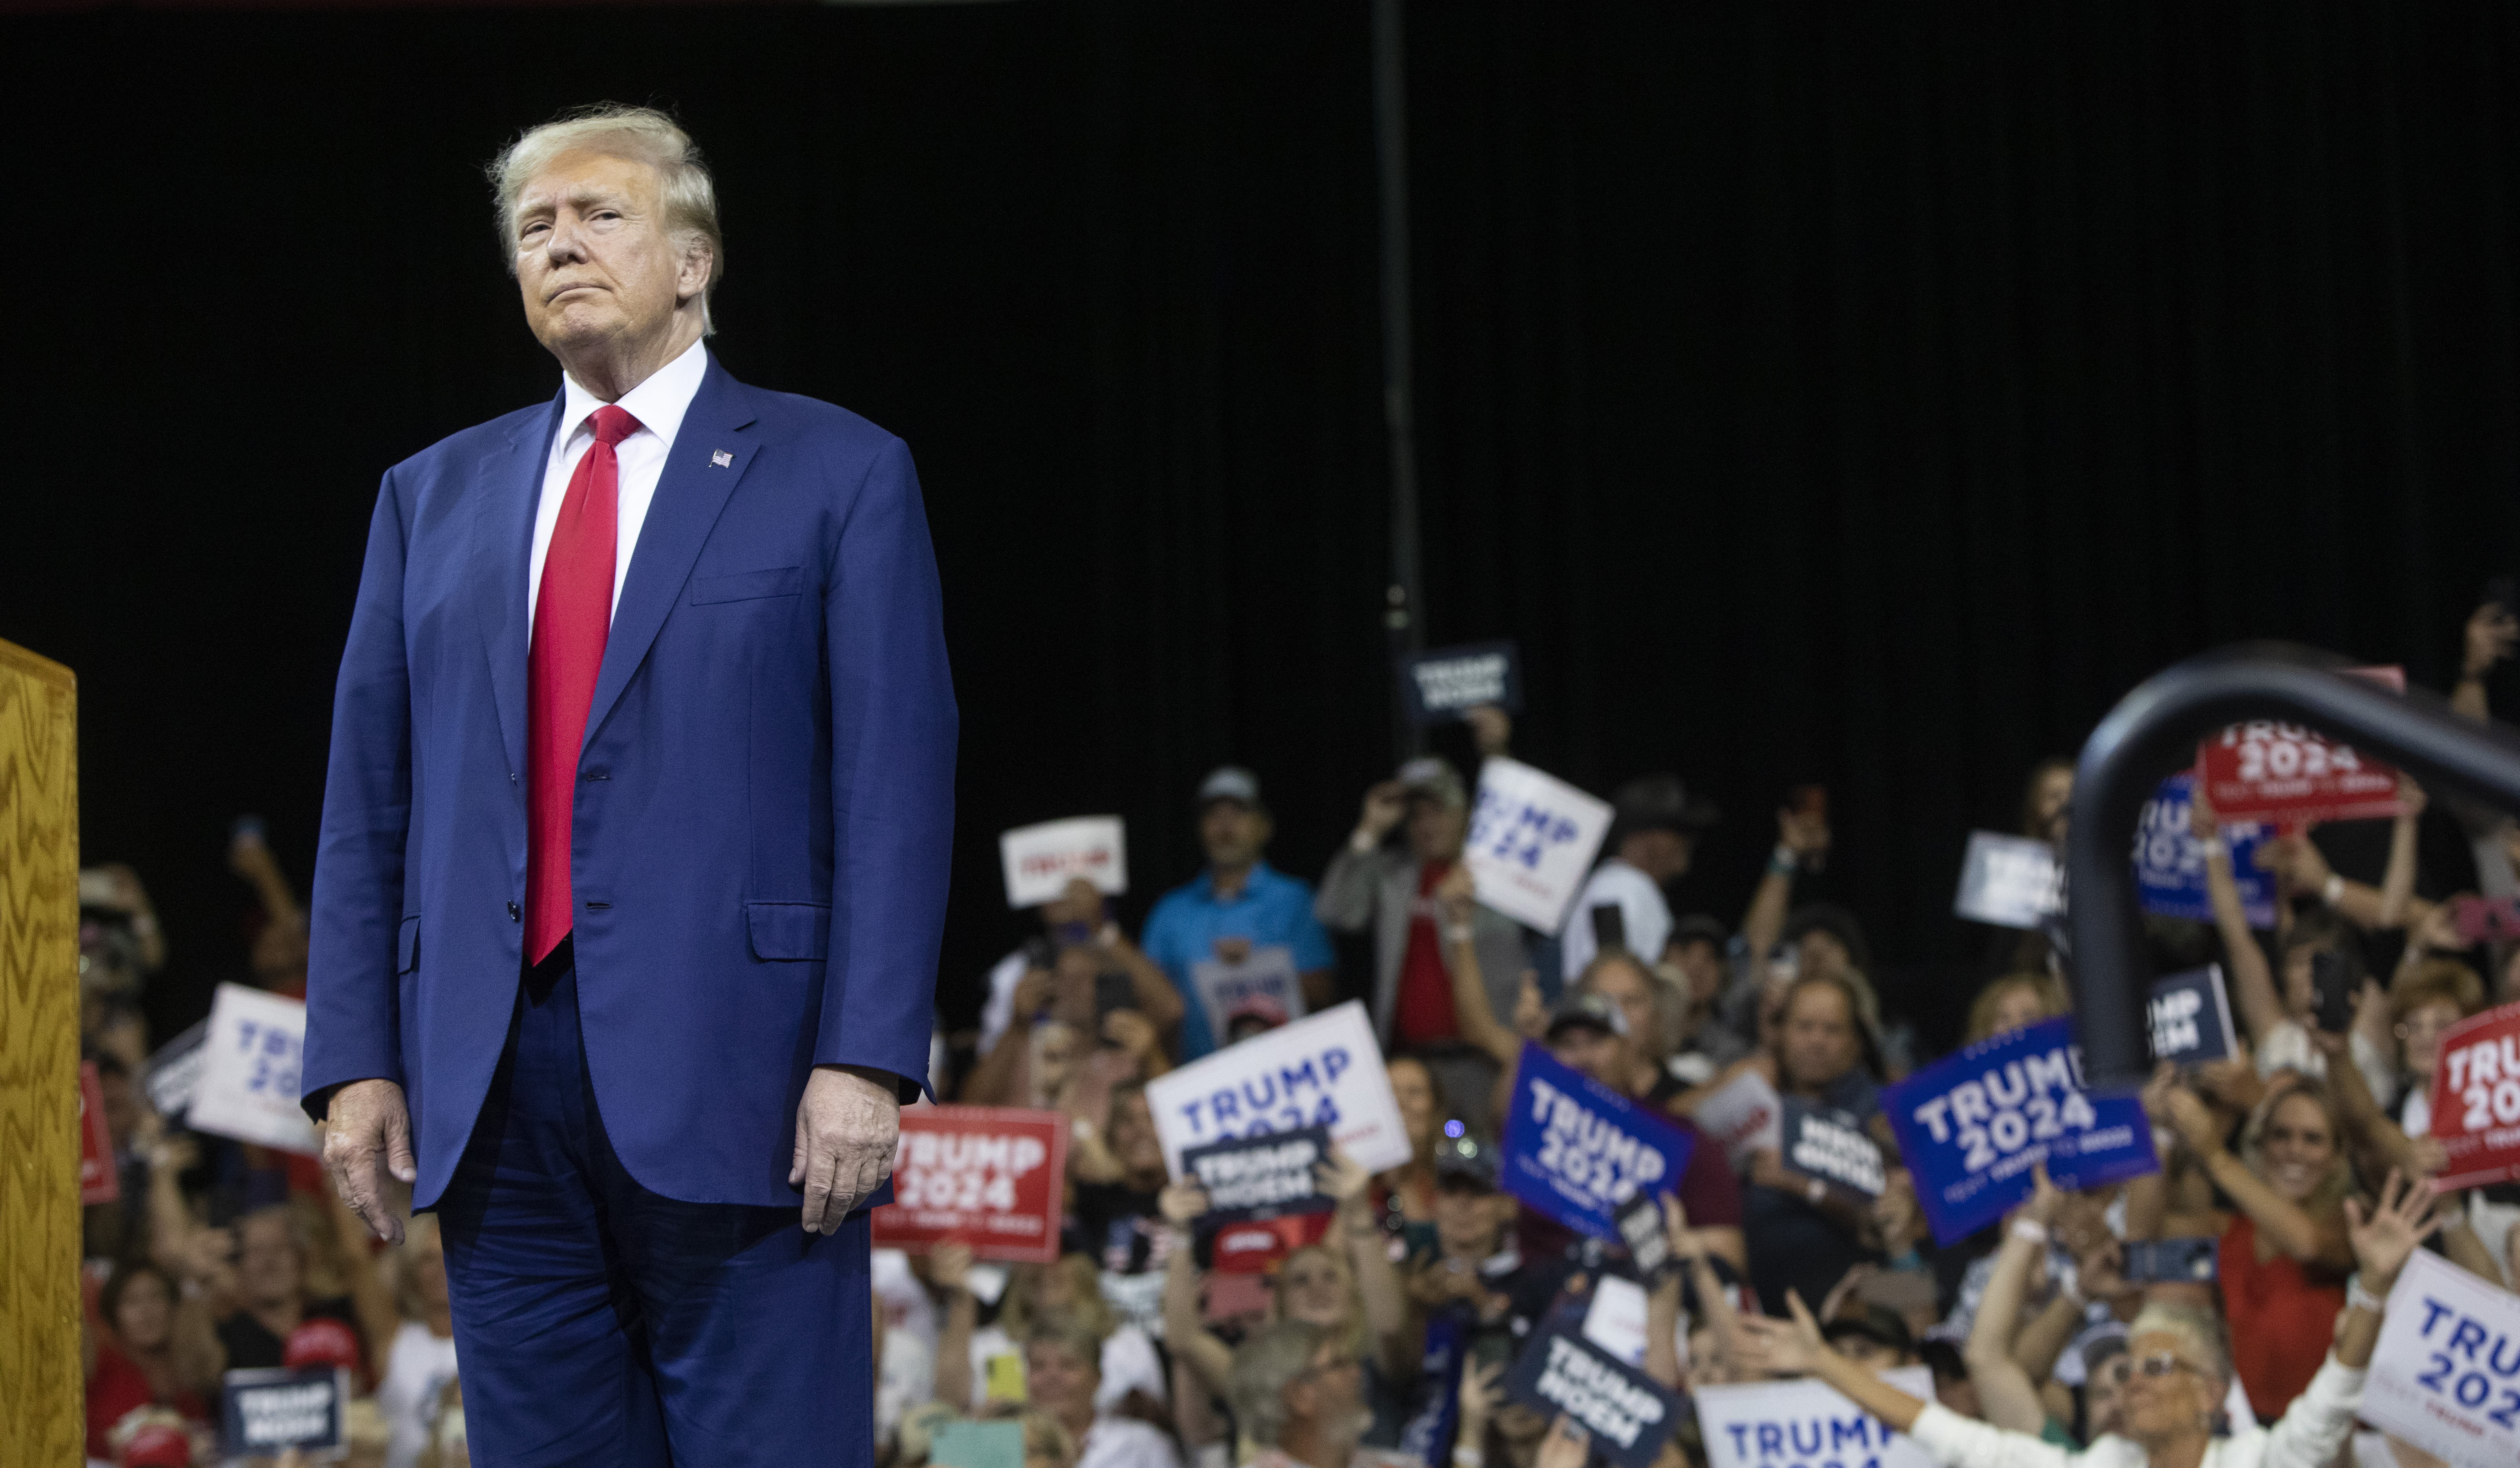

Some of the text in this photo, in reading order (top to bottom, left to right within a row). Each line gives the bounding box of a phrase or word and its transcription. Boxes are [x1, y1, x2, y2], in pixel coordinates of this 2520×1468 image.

[2238, 740, 2359, 782] 2024
[1180, 1045, 1352, 1135] TRUMP
[1530, 1077, 1666, 1183] TRUMP
[1912, 1046, 2087, 1143] TRUM
[894, 1131, 1046, 1176] TRUMP
[1192, 1137, 1319, 1183] TRUMP
[1957, 1092, 2097, 1172] 2024
[897, 1170, 1017, 1210] 2024
[1550, 1335, 1665, 1424] TRUMP
